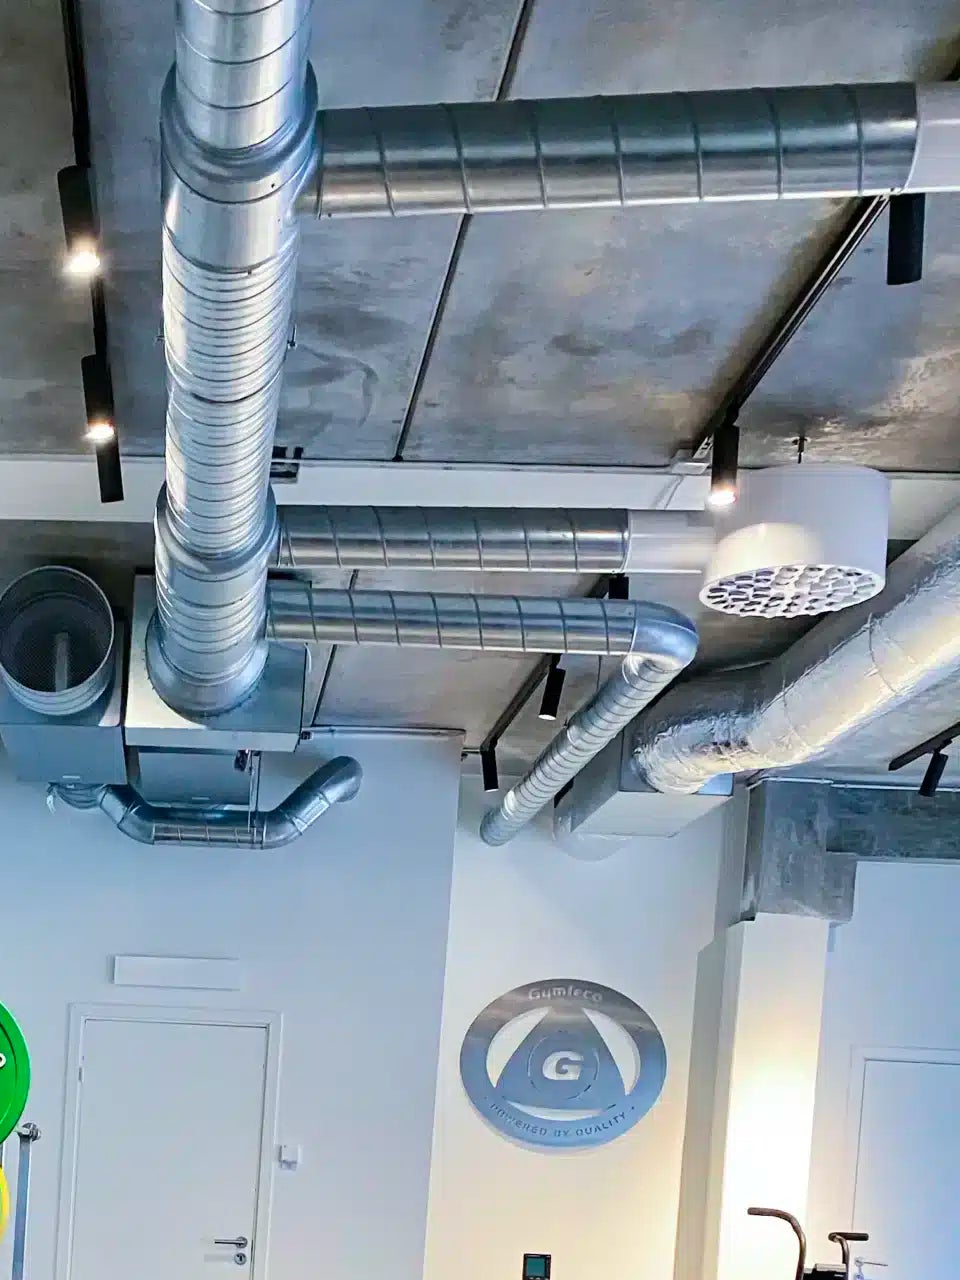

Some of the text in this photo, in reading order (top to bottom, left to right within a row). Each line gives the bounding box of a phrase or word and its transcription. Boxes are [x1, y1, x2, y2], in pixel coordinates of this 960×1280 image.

[528, 985, 603, 1001] Gymleco
[542, 1051, 585, 1081] G
[575, 1111, 626, 1137] QUALITY
